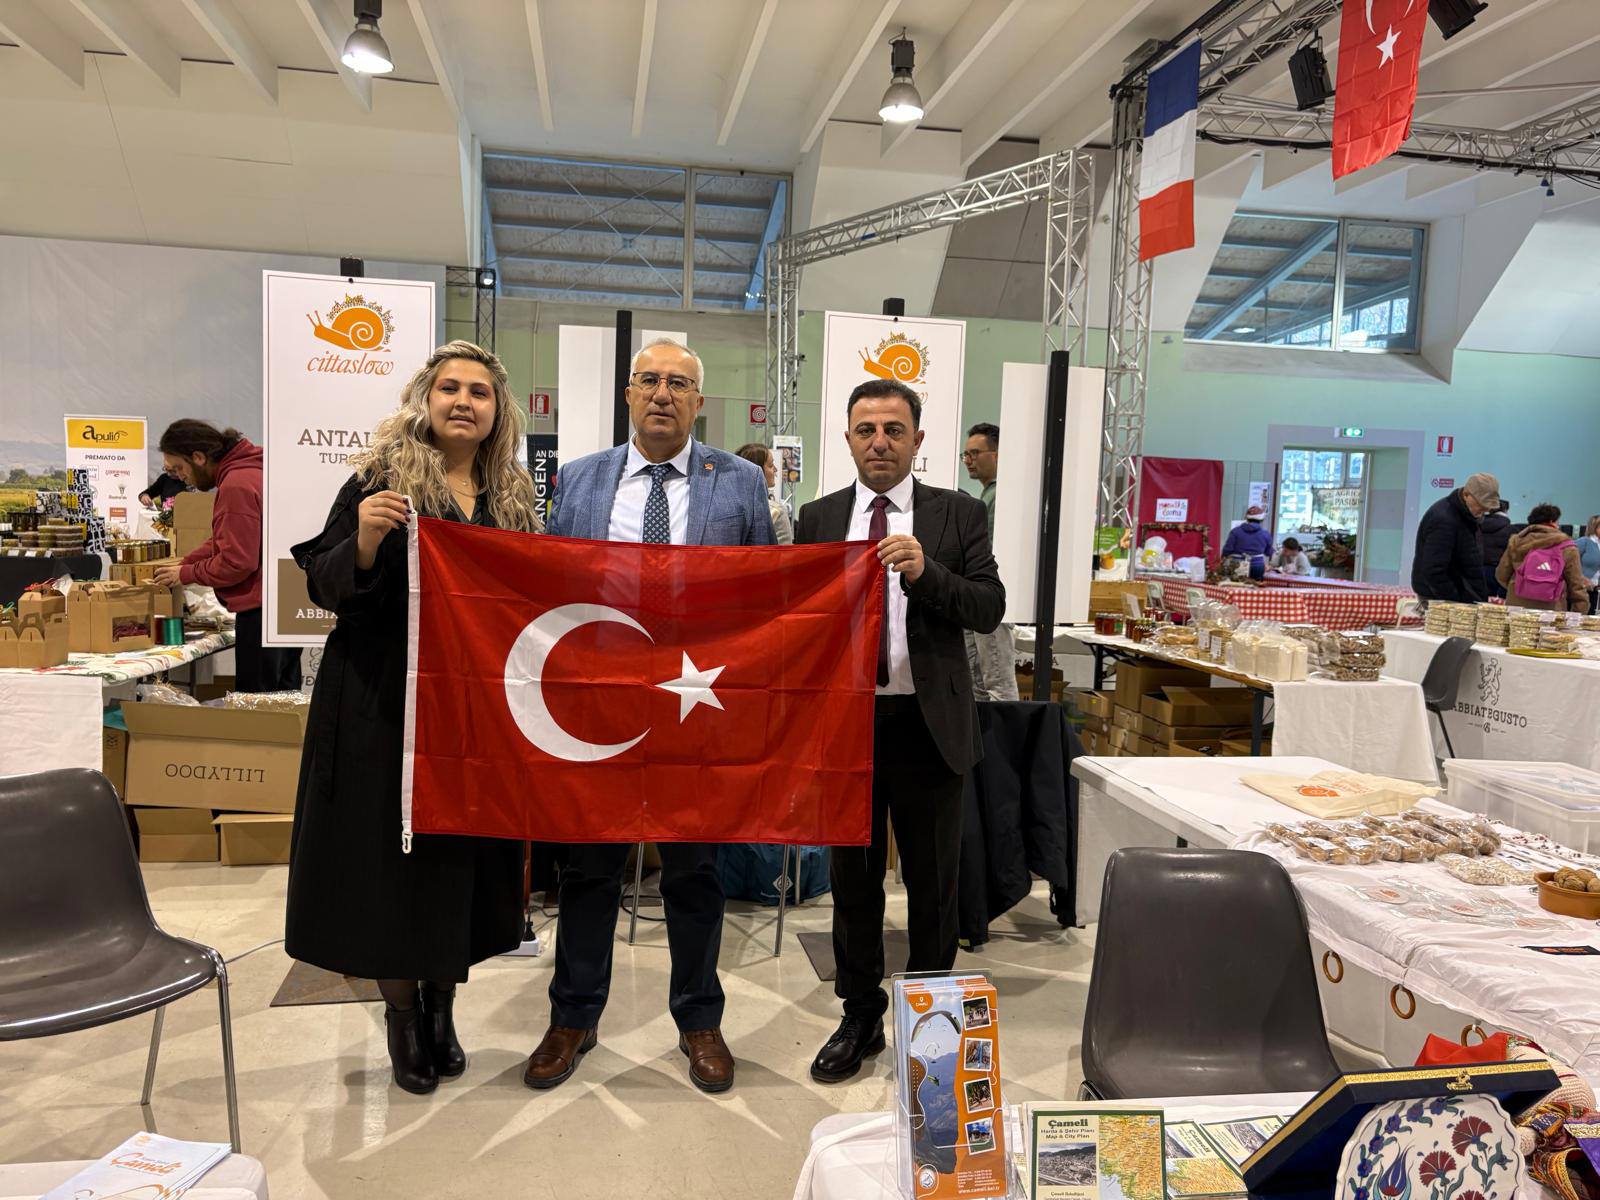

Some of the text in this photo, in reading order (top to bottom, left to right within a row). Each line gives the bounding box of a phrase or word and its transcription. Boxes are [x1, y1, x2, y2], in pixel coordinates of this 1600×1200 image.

[307, 350, 394, 375] cittaslow
[297, 428, 373, 448] ANTAL
[536, 450, 547, 459] AN
[296, 608, 338, 619] ABBIA
[165, 763, 265, 783] LILLYDOO
